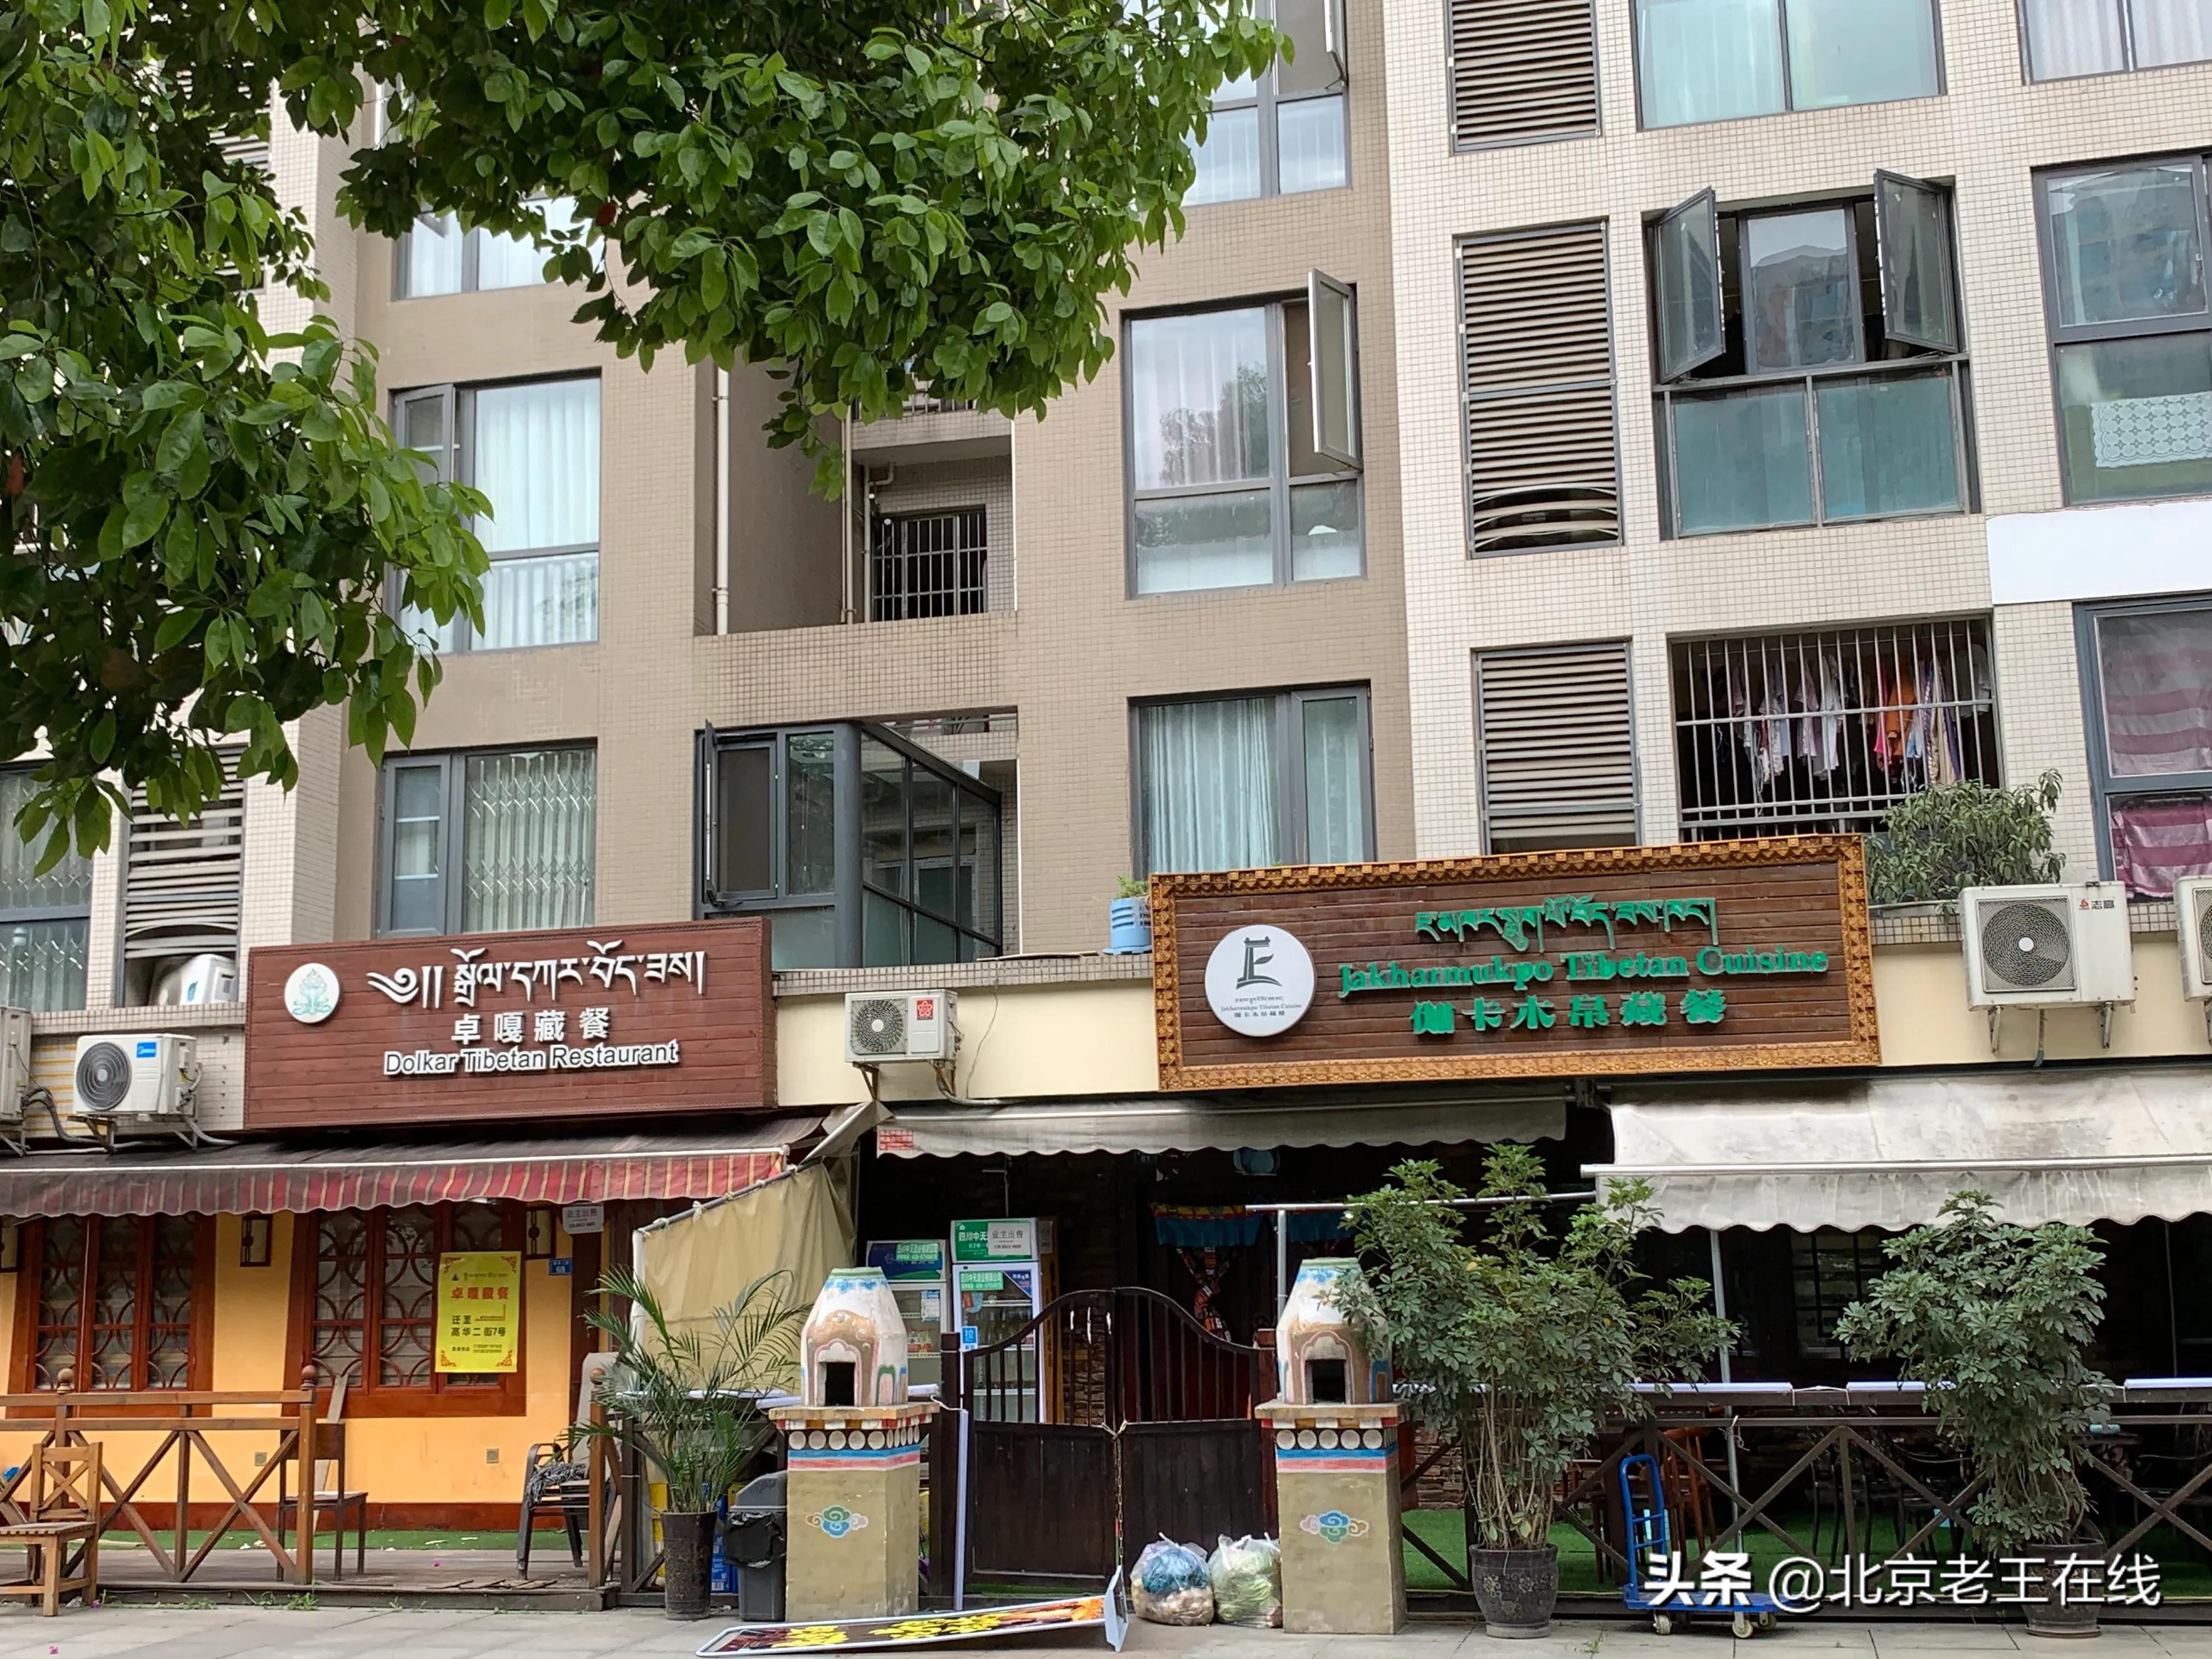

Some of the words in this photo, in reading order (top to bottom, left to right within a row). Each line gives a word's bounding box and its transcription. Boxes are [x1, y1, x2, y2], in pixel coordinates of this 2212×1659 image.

[1338, 956, 1553, 998] Jakharmukpo
[1560, 951, 1689, 981] Tibetan
[1696, 946, 1830, 975] Cuisine
[451, 1007, 610, 1045] 卓嘎藏餐
[385, 1049, 459, 1075] Dolkar
[463, 1047, 546, 1073] Tibetan
[550, 1040, 680, 1069] Restaurant
